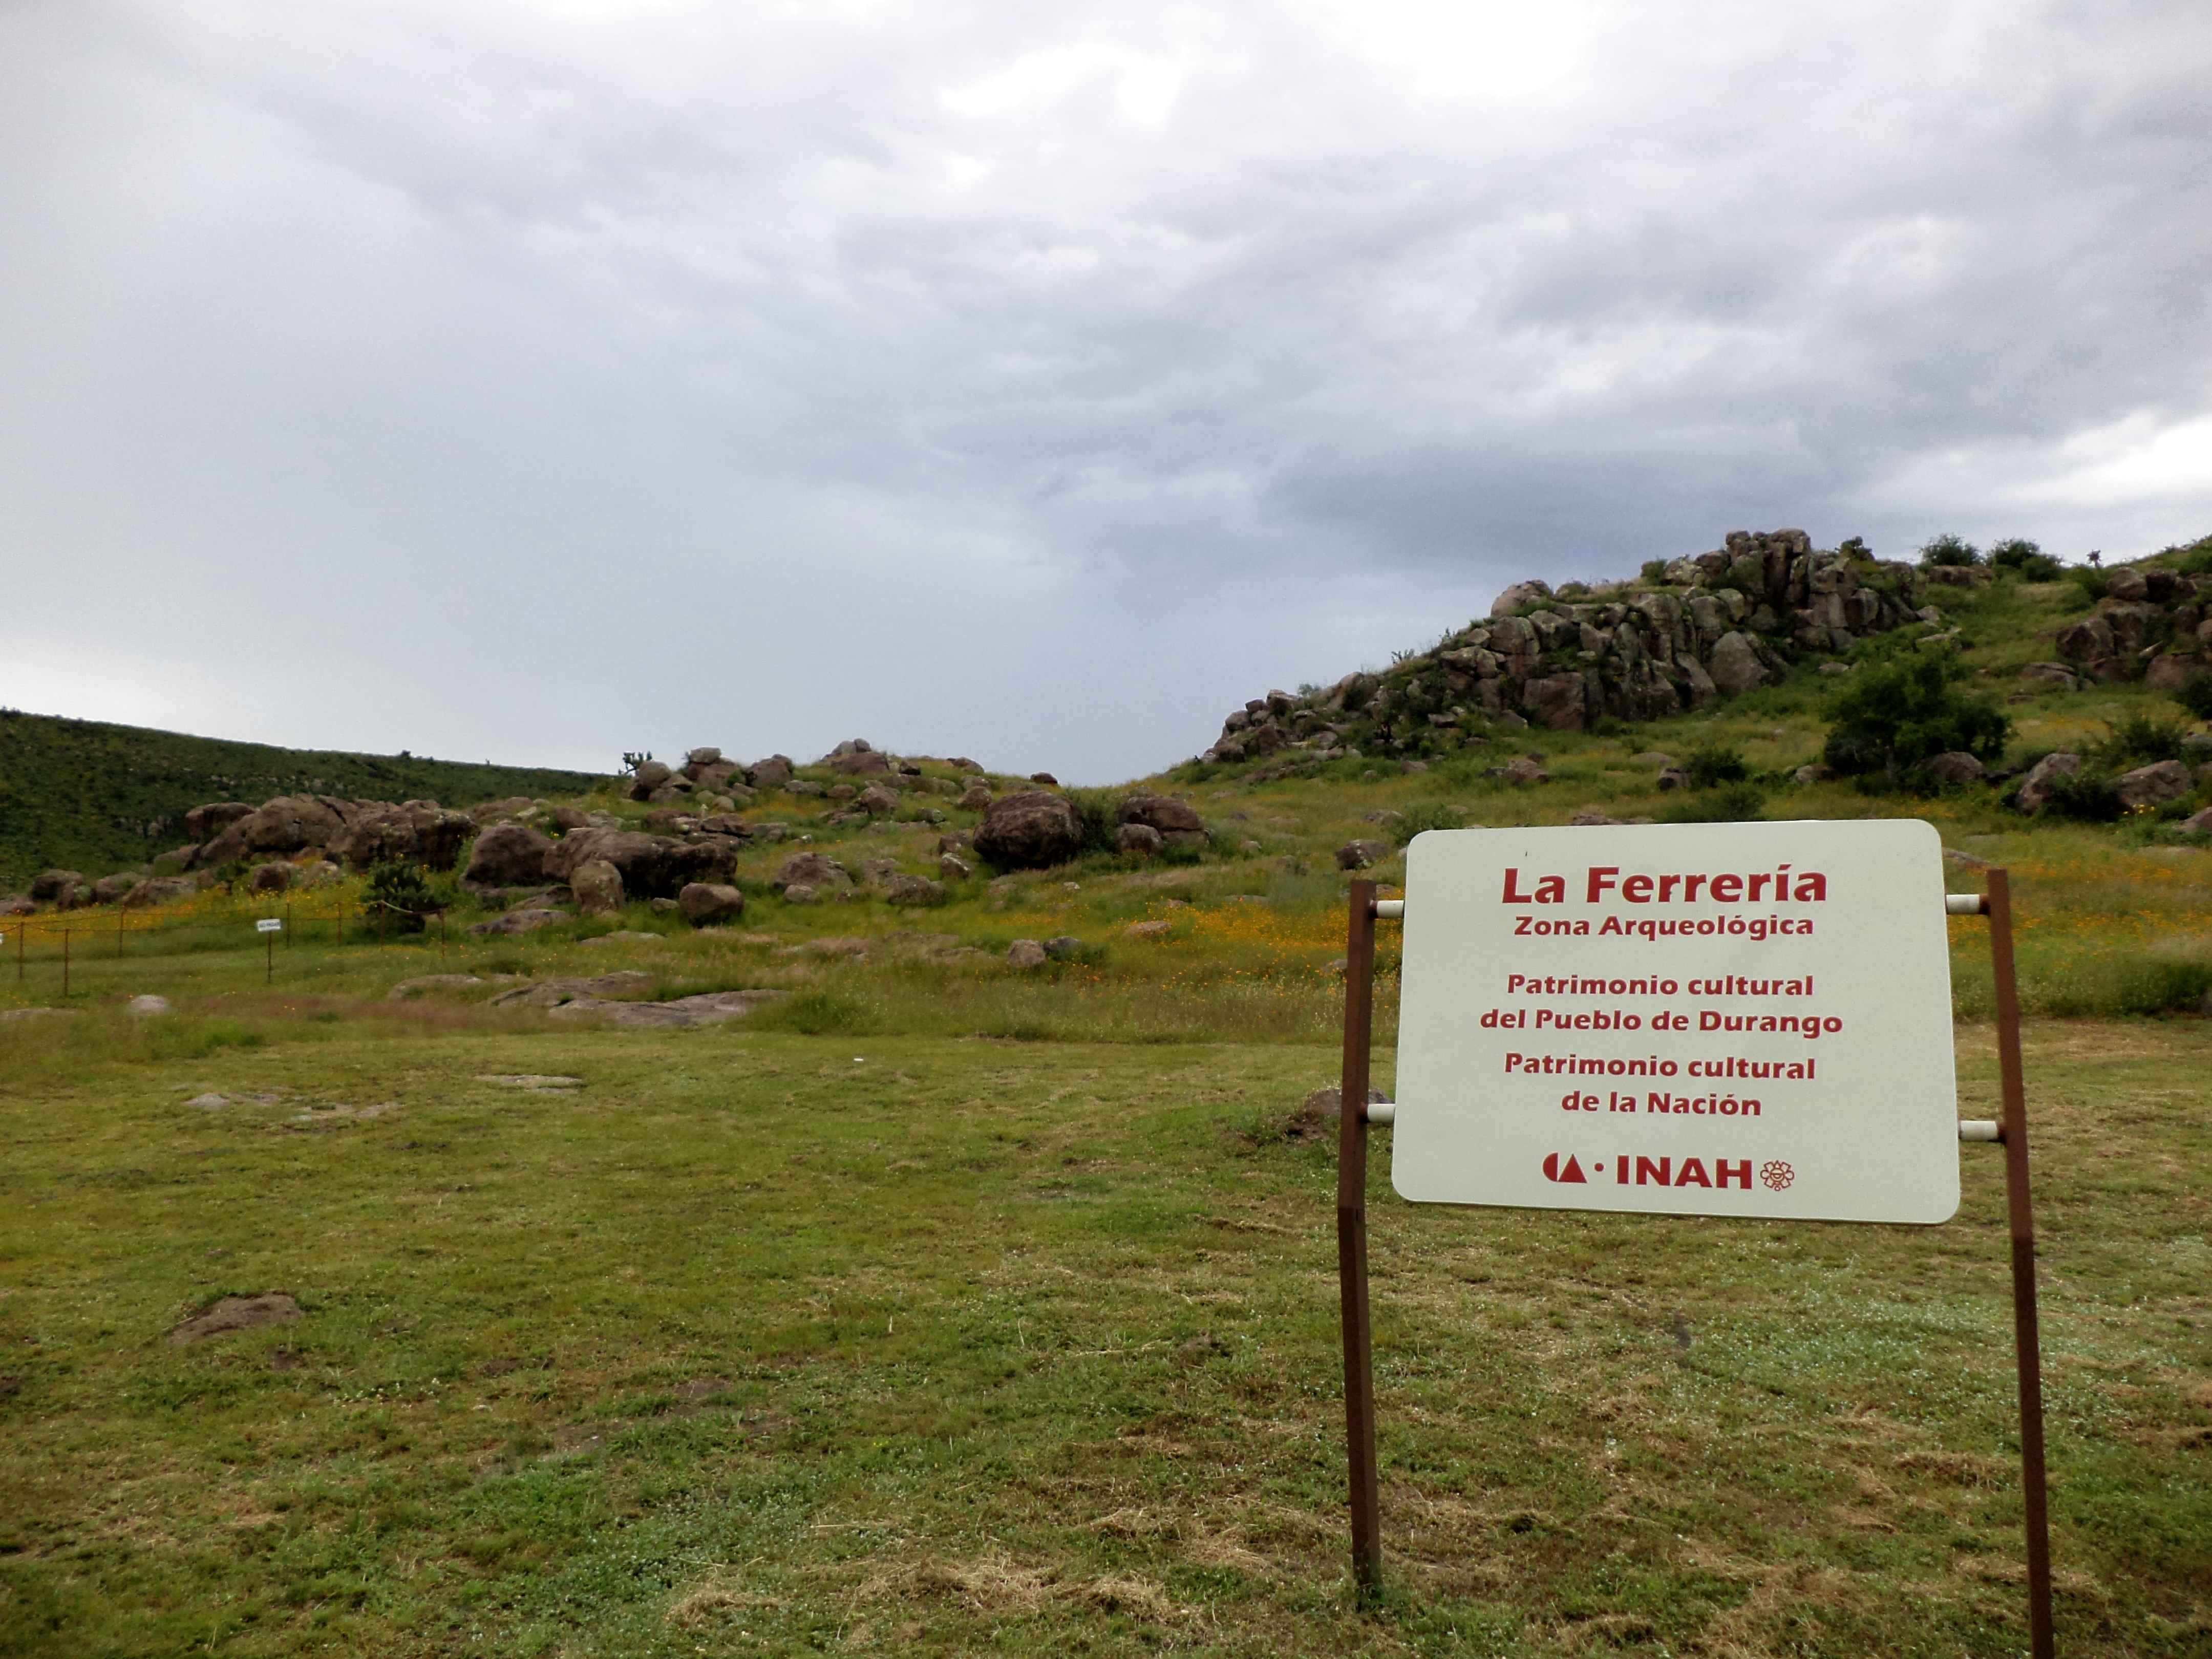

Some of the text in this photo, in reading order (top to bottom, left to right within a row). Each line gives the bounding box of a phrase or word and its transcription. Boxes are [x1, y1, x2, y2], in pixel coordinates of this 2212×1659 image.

[1502, 864, 1826, 904] La Ferrería
[1514, 916, 1813, 942] Zona Arqueológica
[1507, 974, 1813, 996] Patrimonio cultural
[1480, 1009, 1842, 1039] del Pueblo de Durango
[1505, 1053, 1814, 1079] Patrimonio cultural
[1561, 1091, 1760, 1116] de la Nación
[1616, 1155, 1752, 1190] INAH
